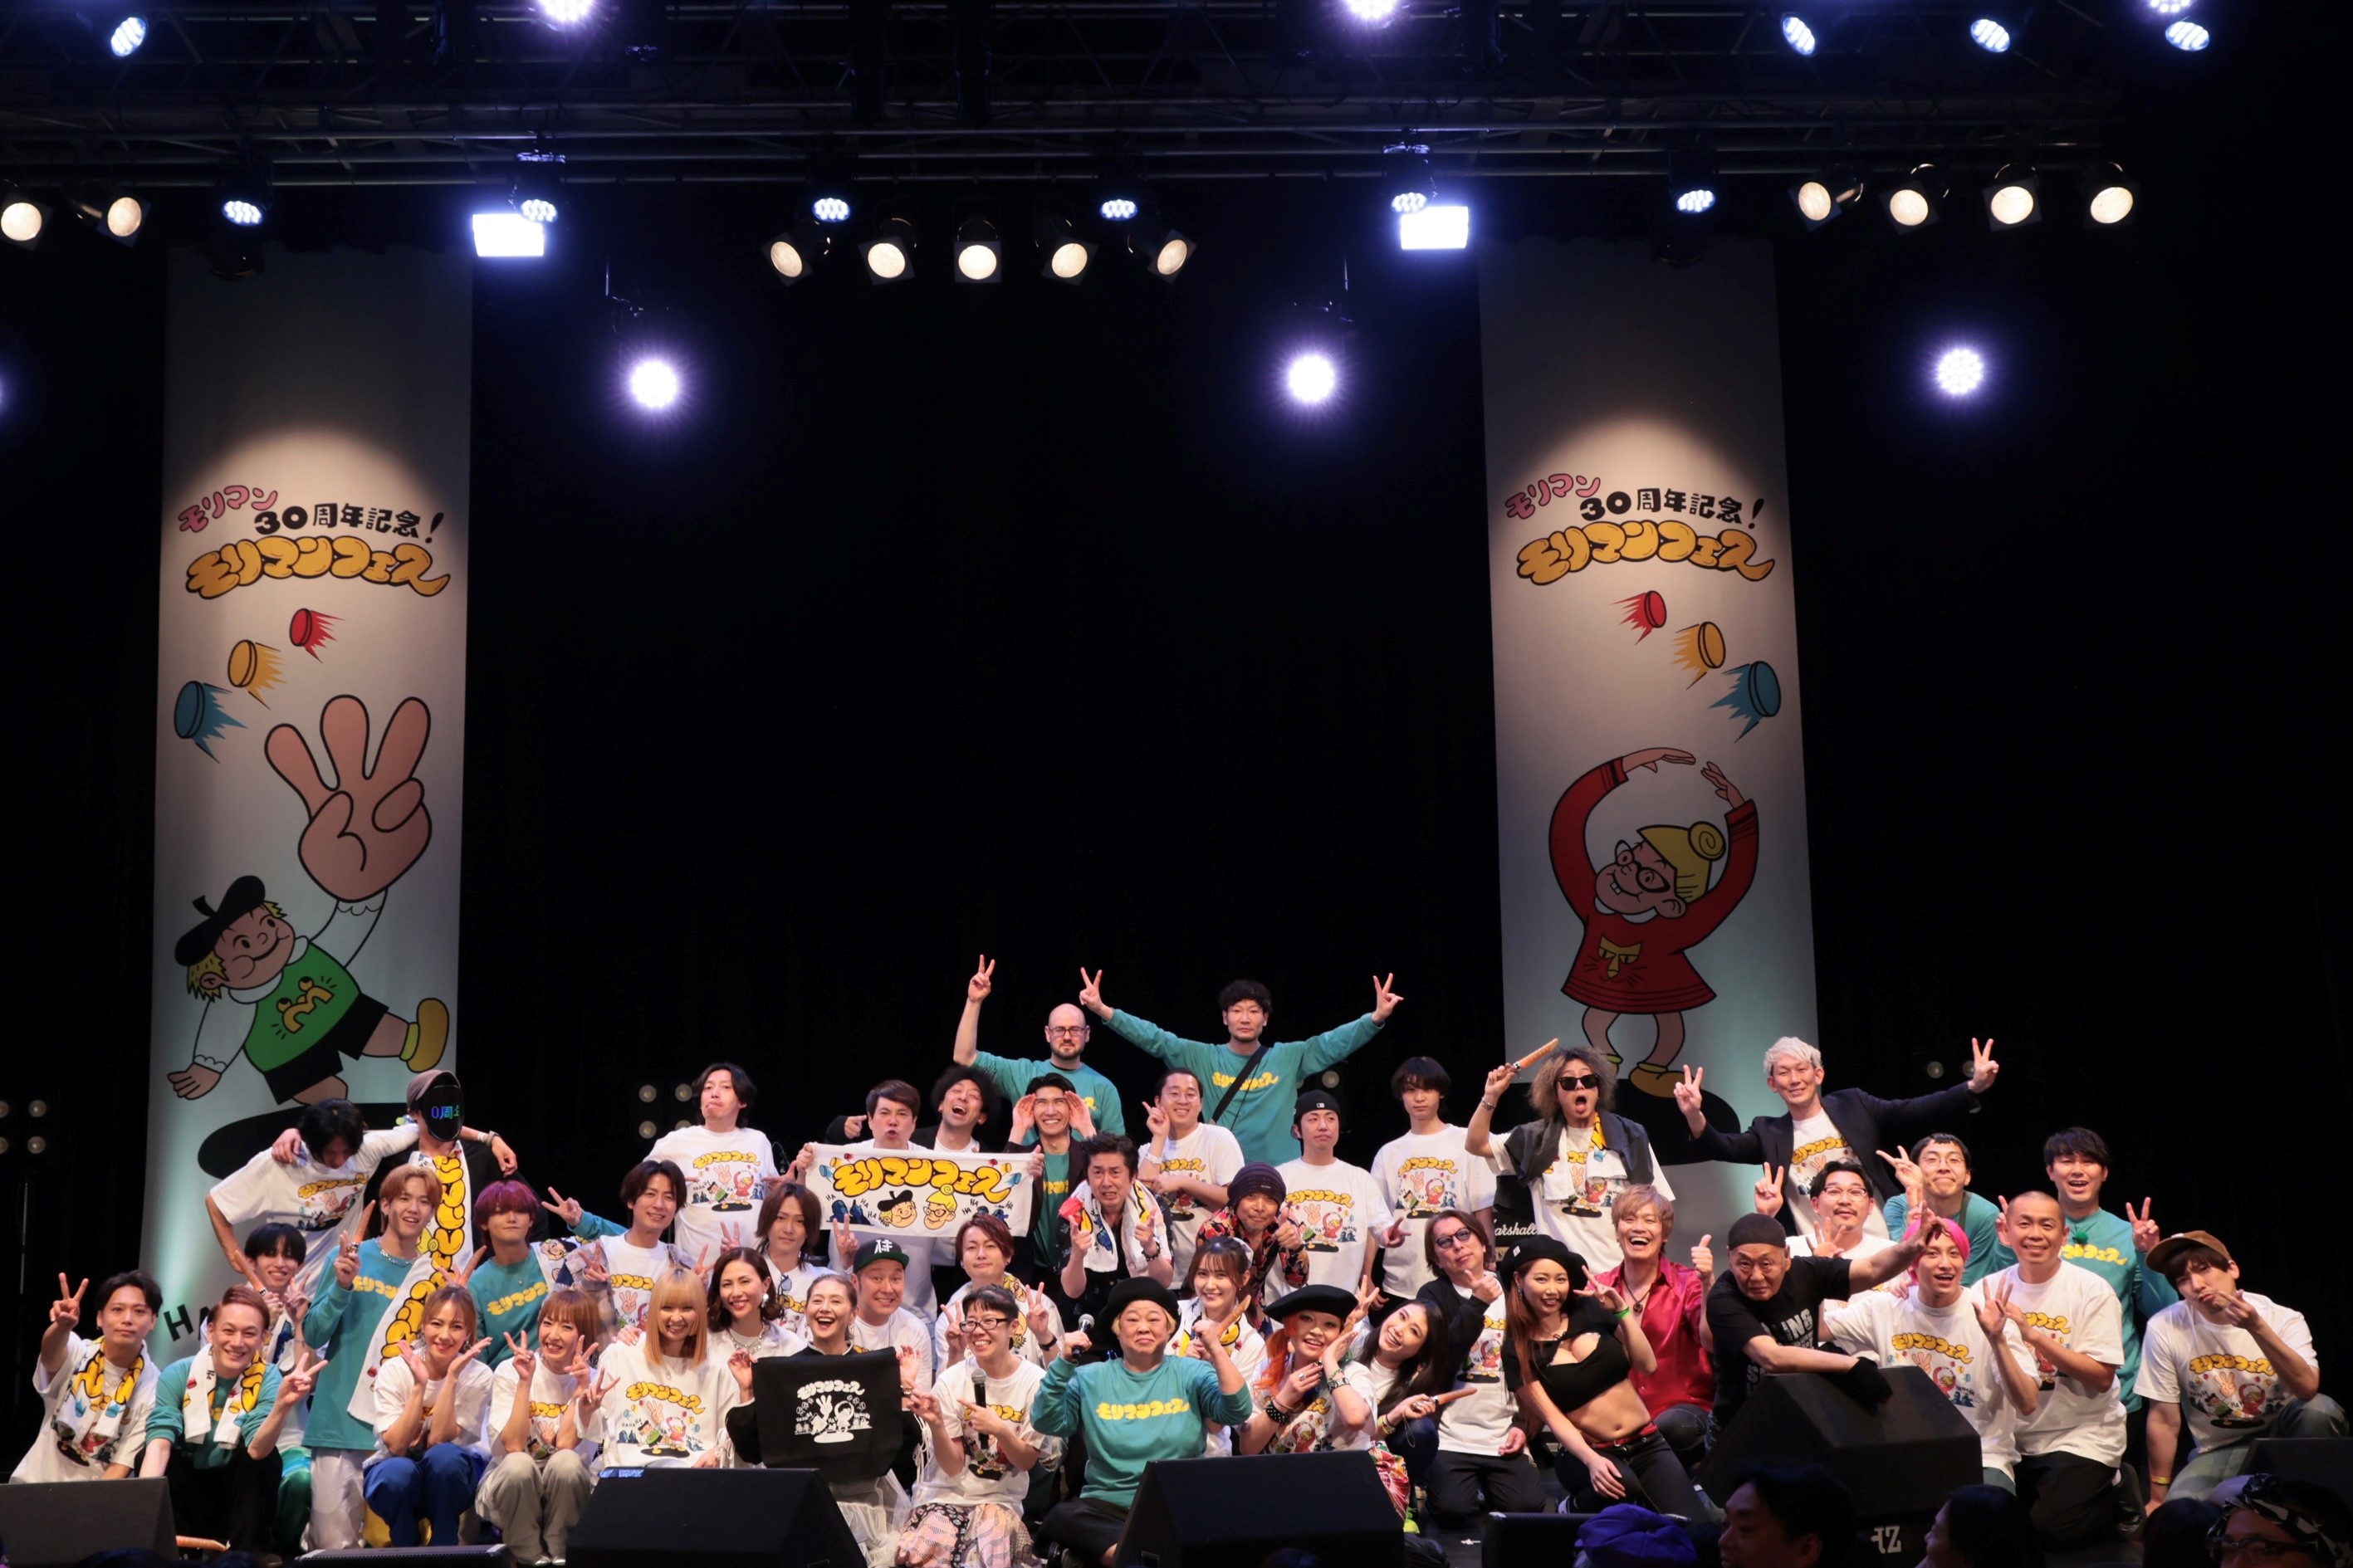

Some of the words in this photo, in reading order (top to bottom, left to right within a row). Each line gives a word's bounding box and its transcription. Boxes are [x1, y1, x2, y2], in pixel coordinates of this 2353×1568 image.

[178, 485, 278, 533] モリマン
[1504, 473, 1601, 520] モリマン
[1579, 487, 1765, 530] 30周年記念!
[254, 502, 445, 544] 30周年記念!
[186, 535, 451, 599] モリマンフェス
[1516, 520, 1775, 585] モリマンフェス
[692, 1150, 761, 1170] モリマンフェス
[833, 1156, 1011, 1204] モリマンフェス
[860, 1199, 868, 1209] HA
[868, 1211, 877, 1219] HA
[1494, 1219, 1538, 1236] arshall
[487, 1282, 549, 1316] モリマンフ
[1891, 1332, 1974, 1365] モリマンフェス
[626, 1381, 706, 1414] モリマンフェス
[797, 1380, 865, 1400] モリマンフェス
[1096, 1398, 1191, 1420] モリマンフェス
